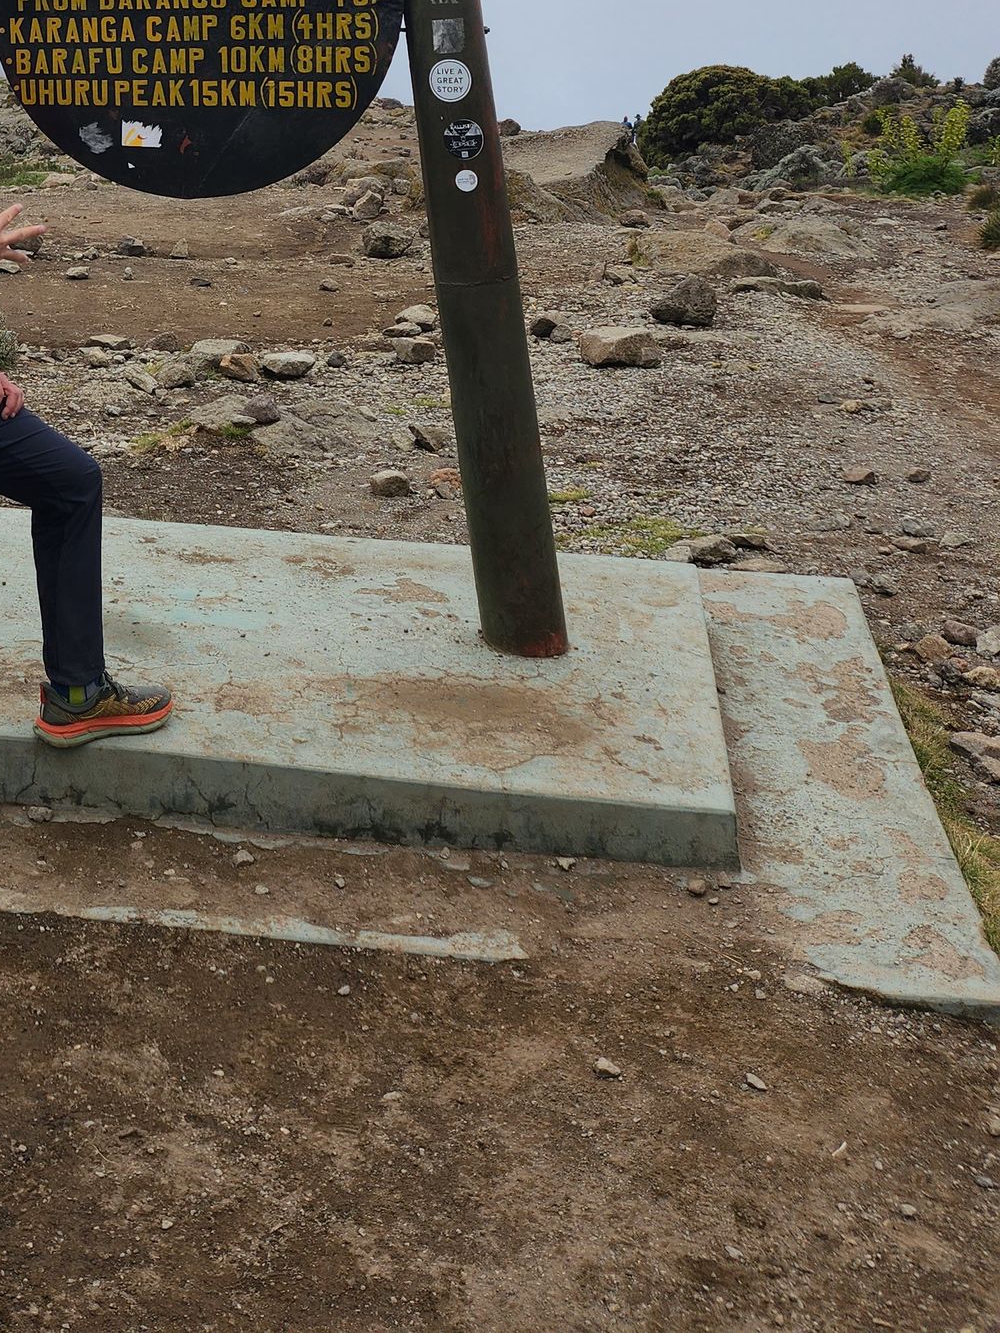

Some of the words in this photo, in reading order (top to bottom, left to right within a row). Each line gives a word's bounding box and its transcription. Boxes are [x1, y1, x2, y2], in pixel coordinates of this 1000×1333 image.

[146, 14, 218, 42] CAMP
[230, 13, 284, 41] 6KM
[291, 8, 379, 44] (4HRS)
[132, 47, 204, 75] CAMP
[218, 45, 285, 74] 10KM
[290, 41, 378, 76] (8HRS)
[114, 79, 186, 107] PEAK
[189, 79, 257, 107] 15KM
[260, 76, 358, 110] (15HRS)
